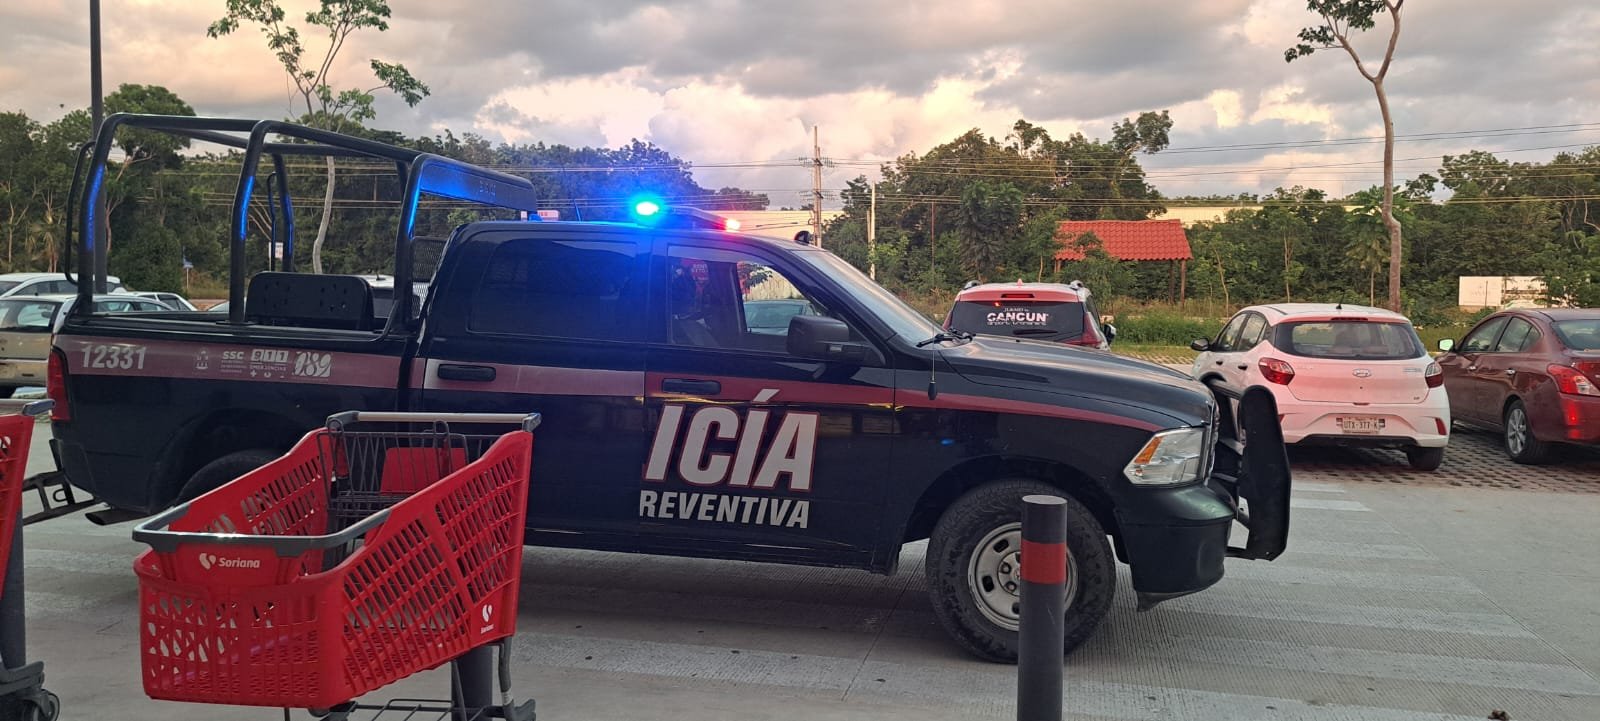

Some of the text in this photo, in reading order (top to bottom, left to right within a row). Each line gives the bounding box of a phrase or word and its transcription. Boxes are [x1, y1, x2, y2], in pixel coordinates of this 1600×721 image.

[987, 312, 1047, 322] CANCUN
[81, 345, 146, 370] 12331
[222, 351, 244, 360] SSC
[250, 349, 288, 362] 911
[644, 388, 819, 491] ICÍA
[639, 490, 810, 529] REVENTIVA
[219, 557, 260, 568] Soriana
